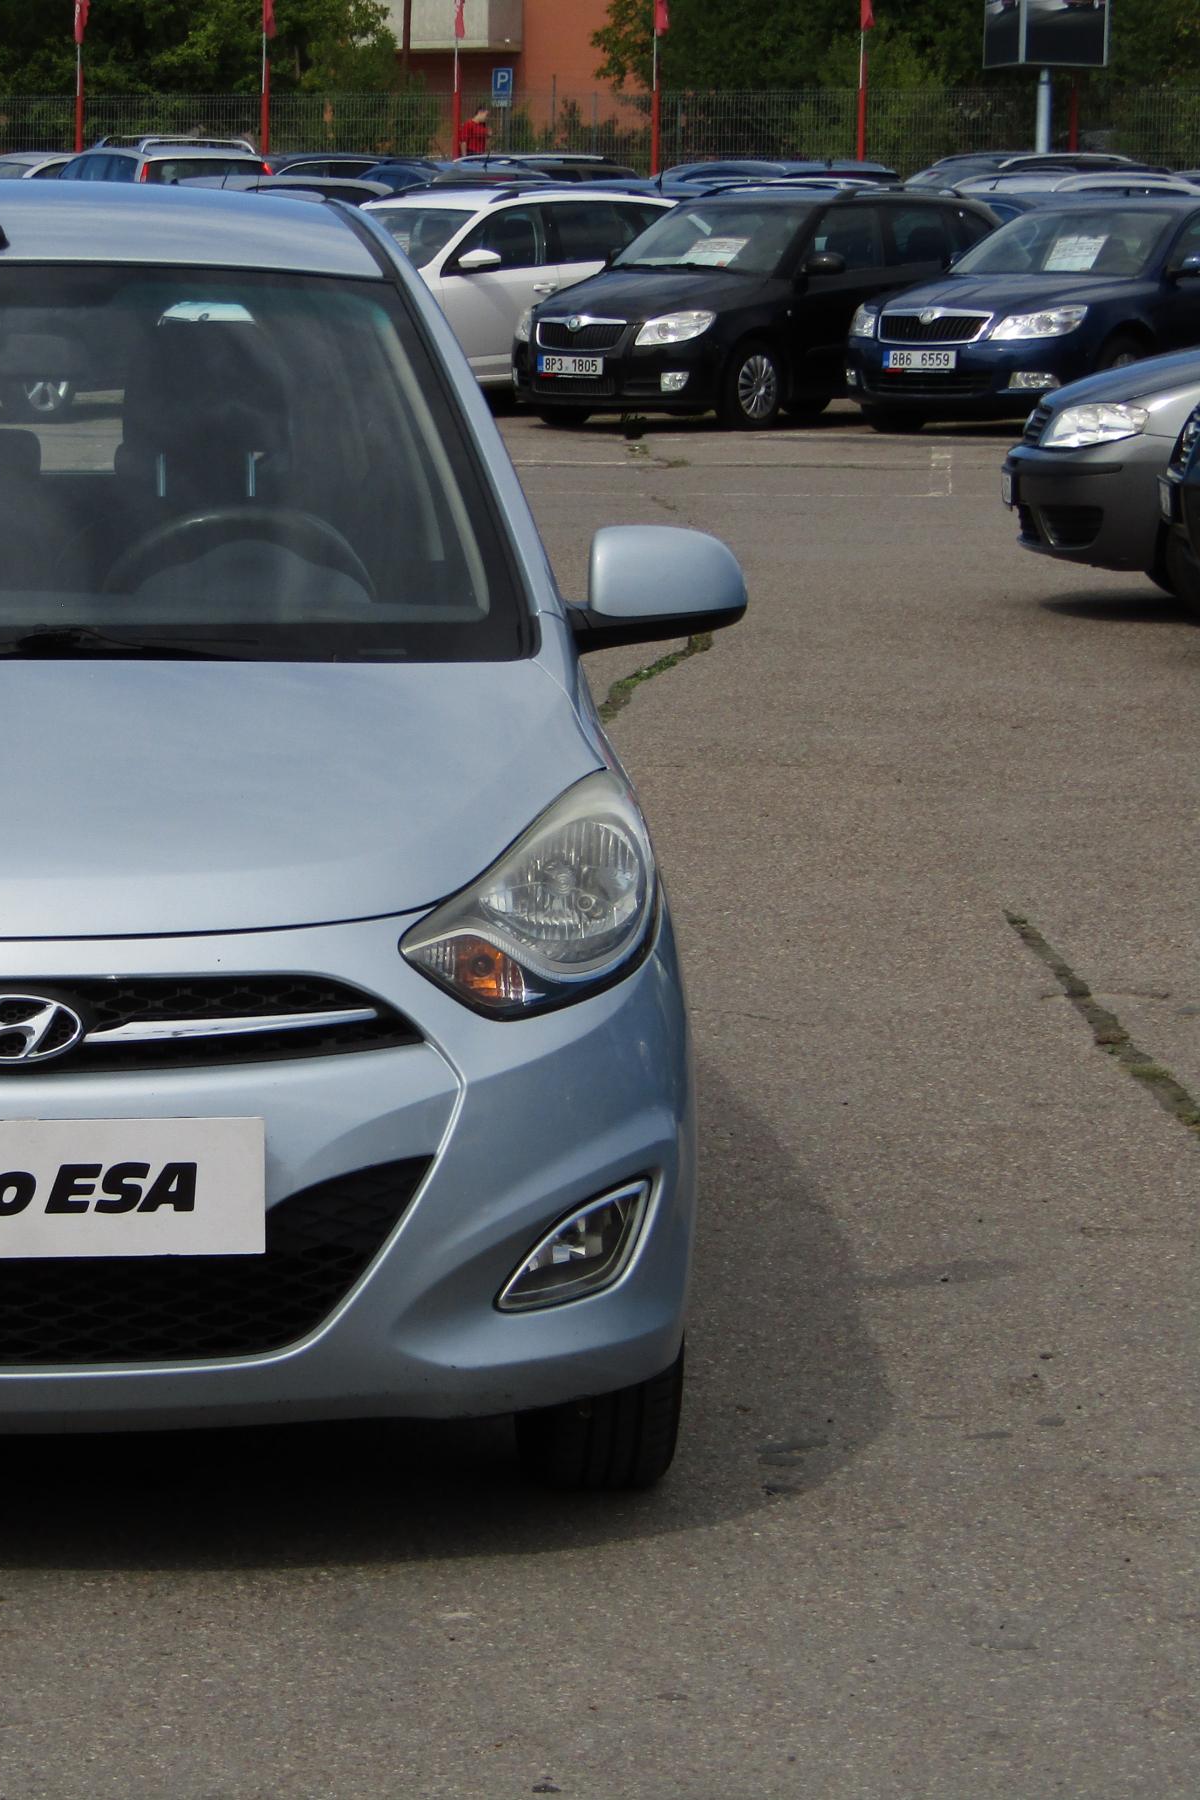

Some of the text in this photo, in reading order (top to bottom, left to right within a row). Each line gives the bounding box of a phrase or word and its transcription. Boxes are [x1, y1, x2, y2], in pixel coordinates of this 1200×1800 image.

[497, 71, 509, 89] P
[545, 358, 598, 372] 8P3 1805
[921, 353, 950, 366] 6559
[44, 1162, 198, 1214] ESA
